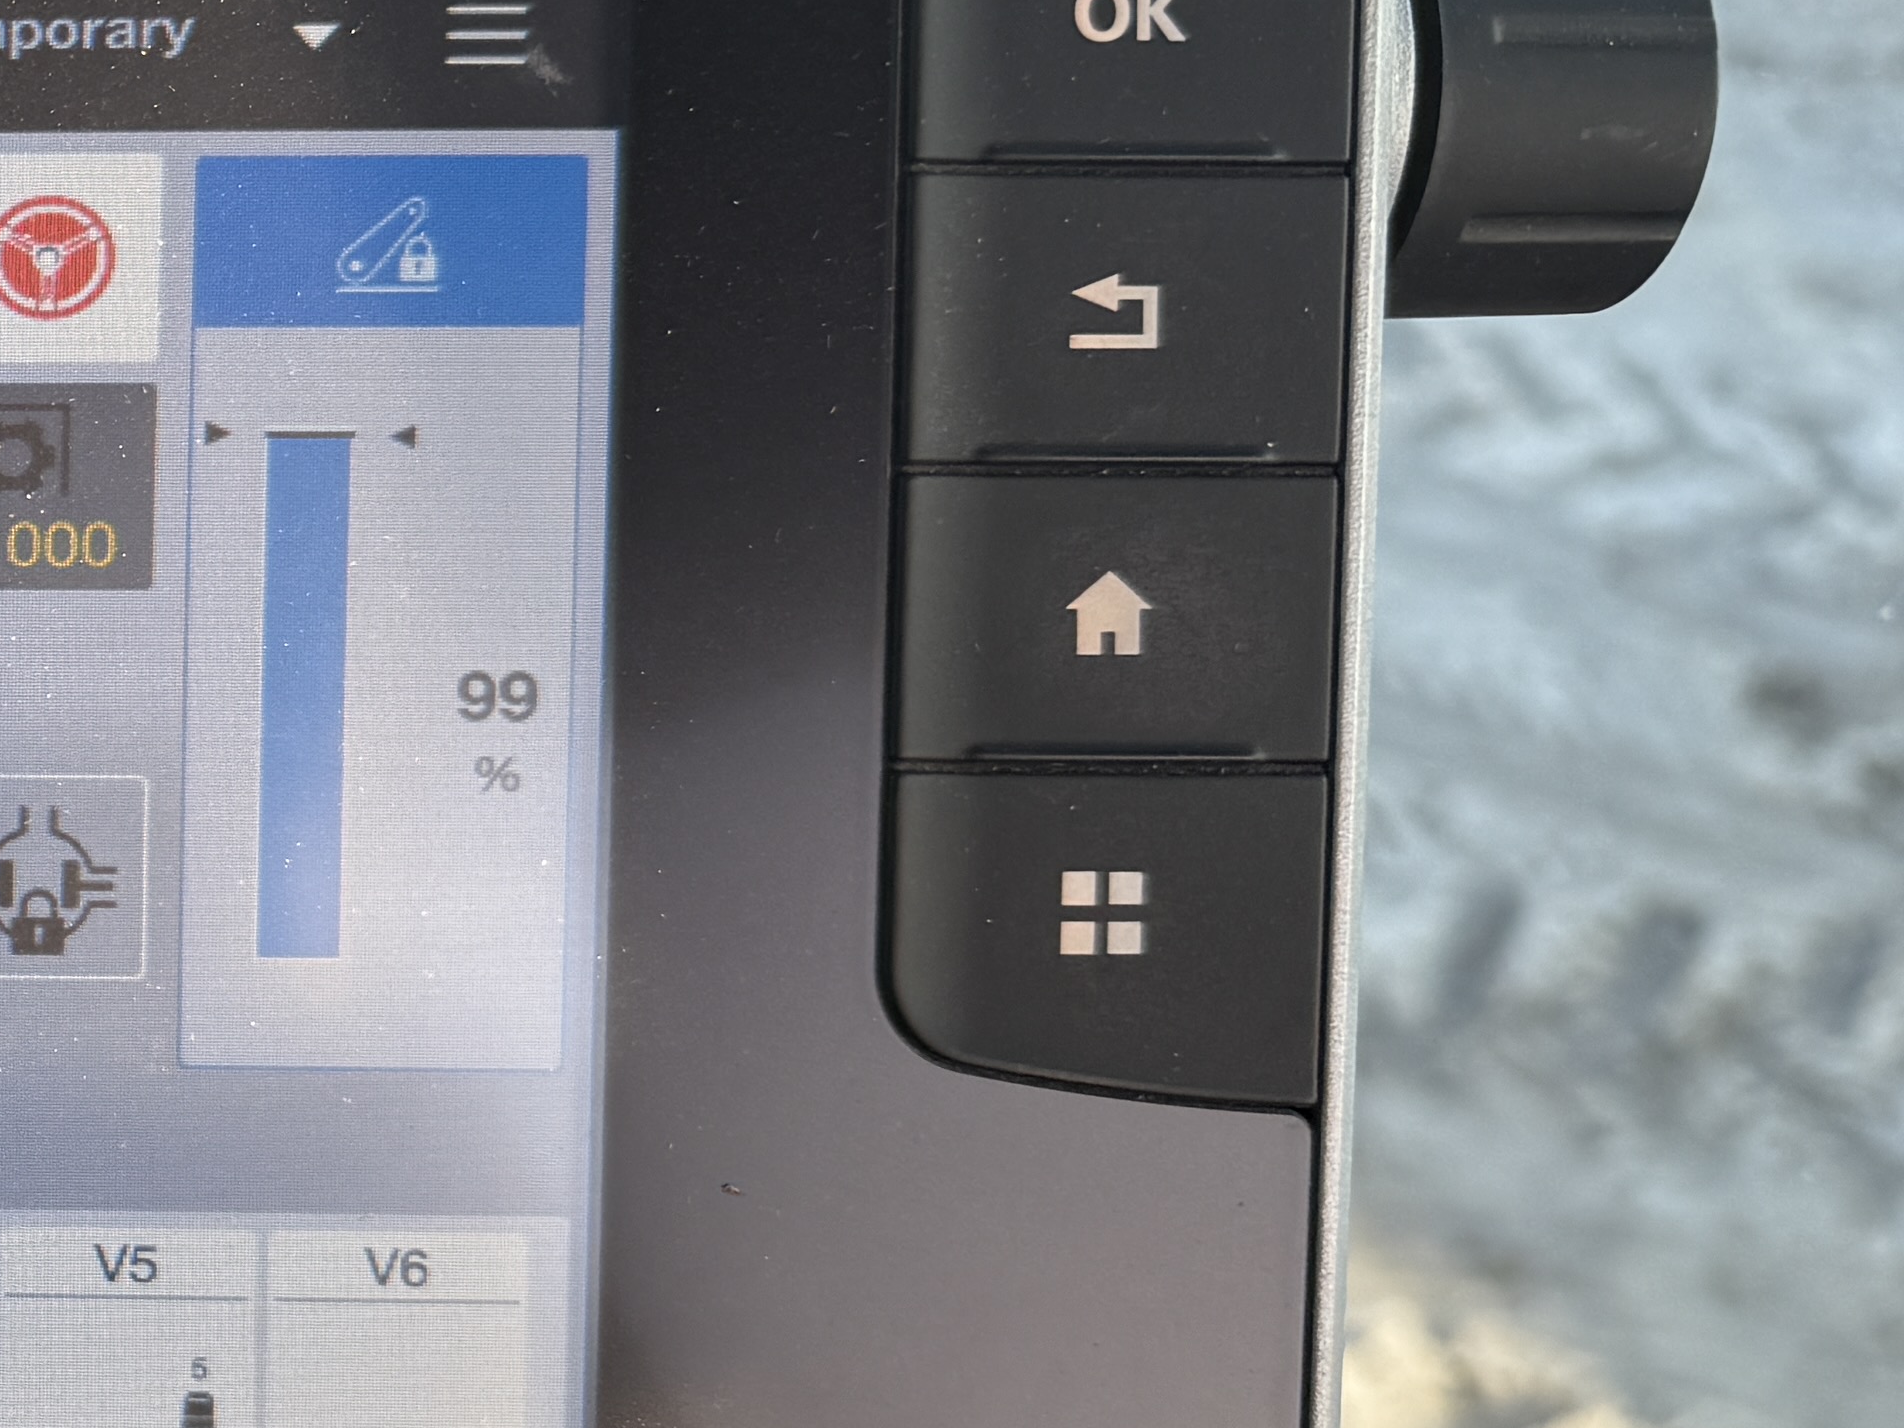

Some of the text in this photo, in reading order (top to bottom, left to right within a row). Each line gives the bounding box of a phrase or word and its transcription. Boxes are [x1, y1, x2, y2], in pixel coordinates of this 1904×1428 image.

[458, 670, 538, 722] 99
[474, 756, 520, 793] %
[94, 1245, 158, 1283] V5
[365, 1248, 429, 1287] V6
